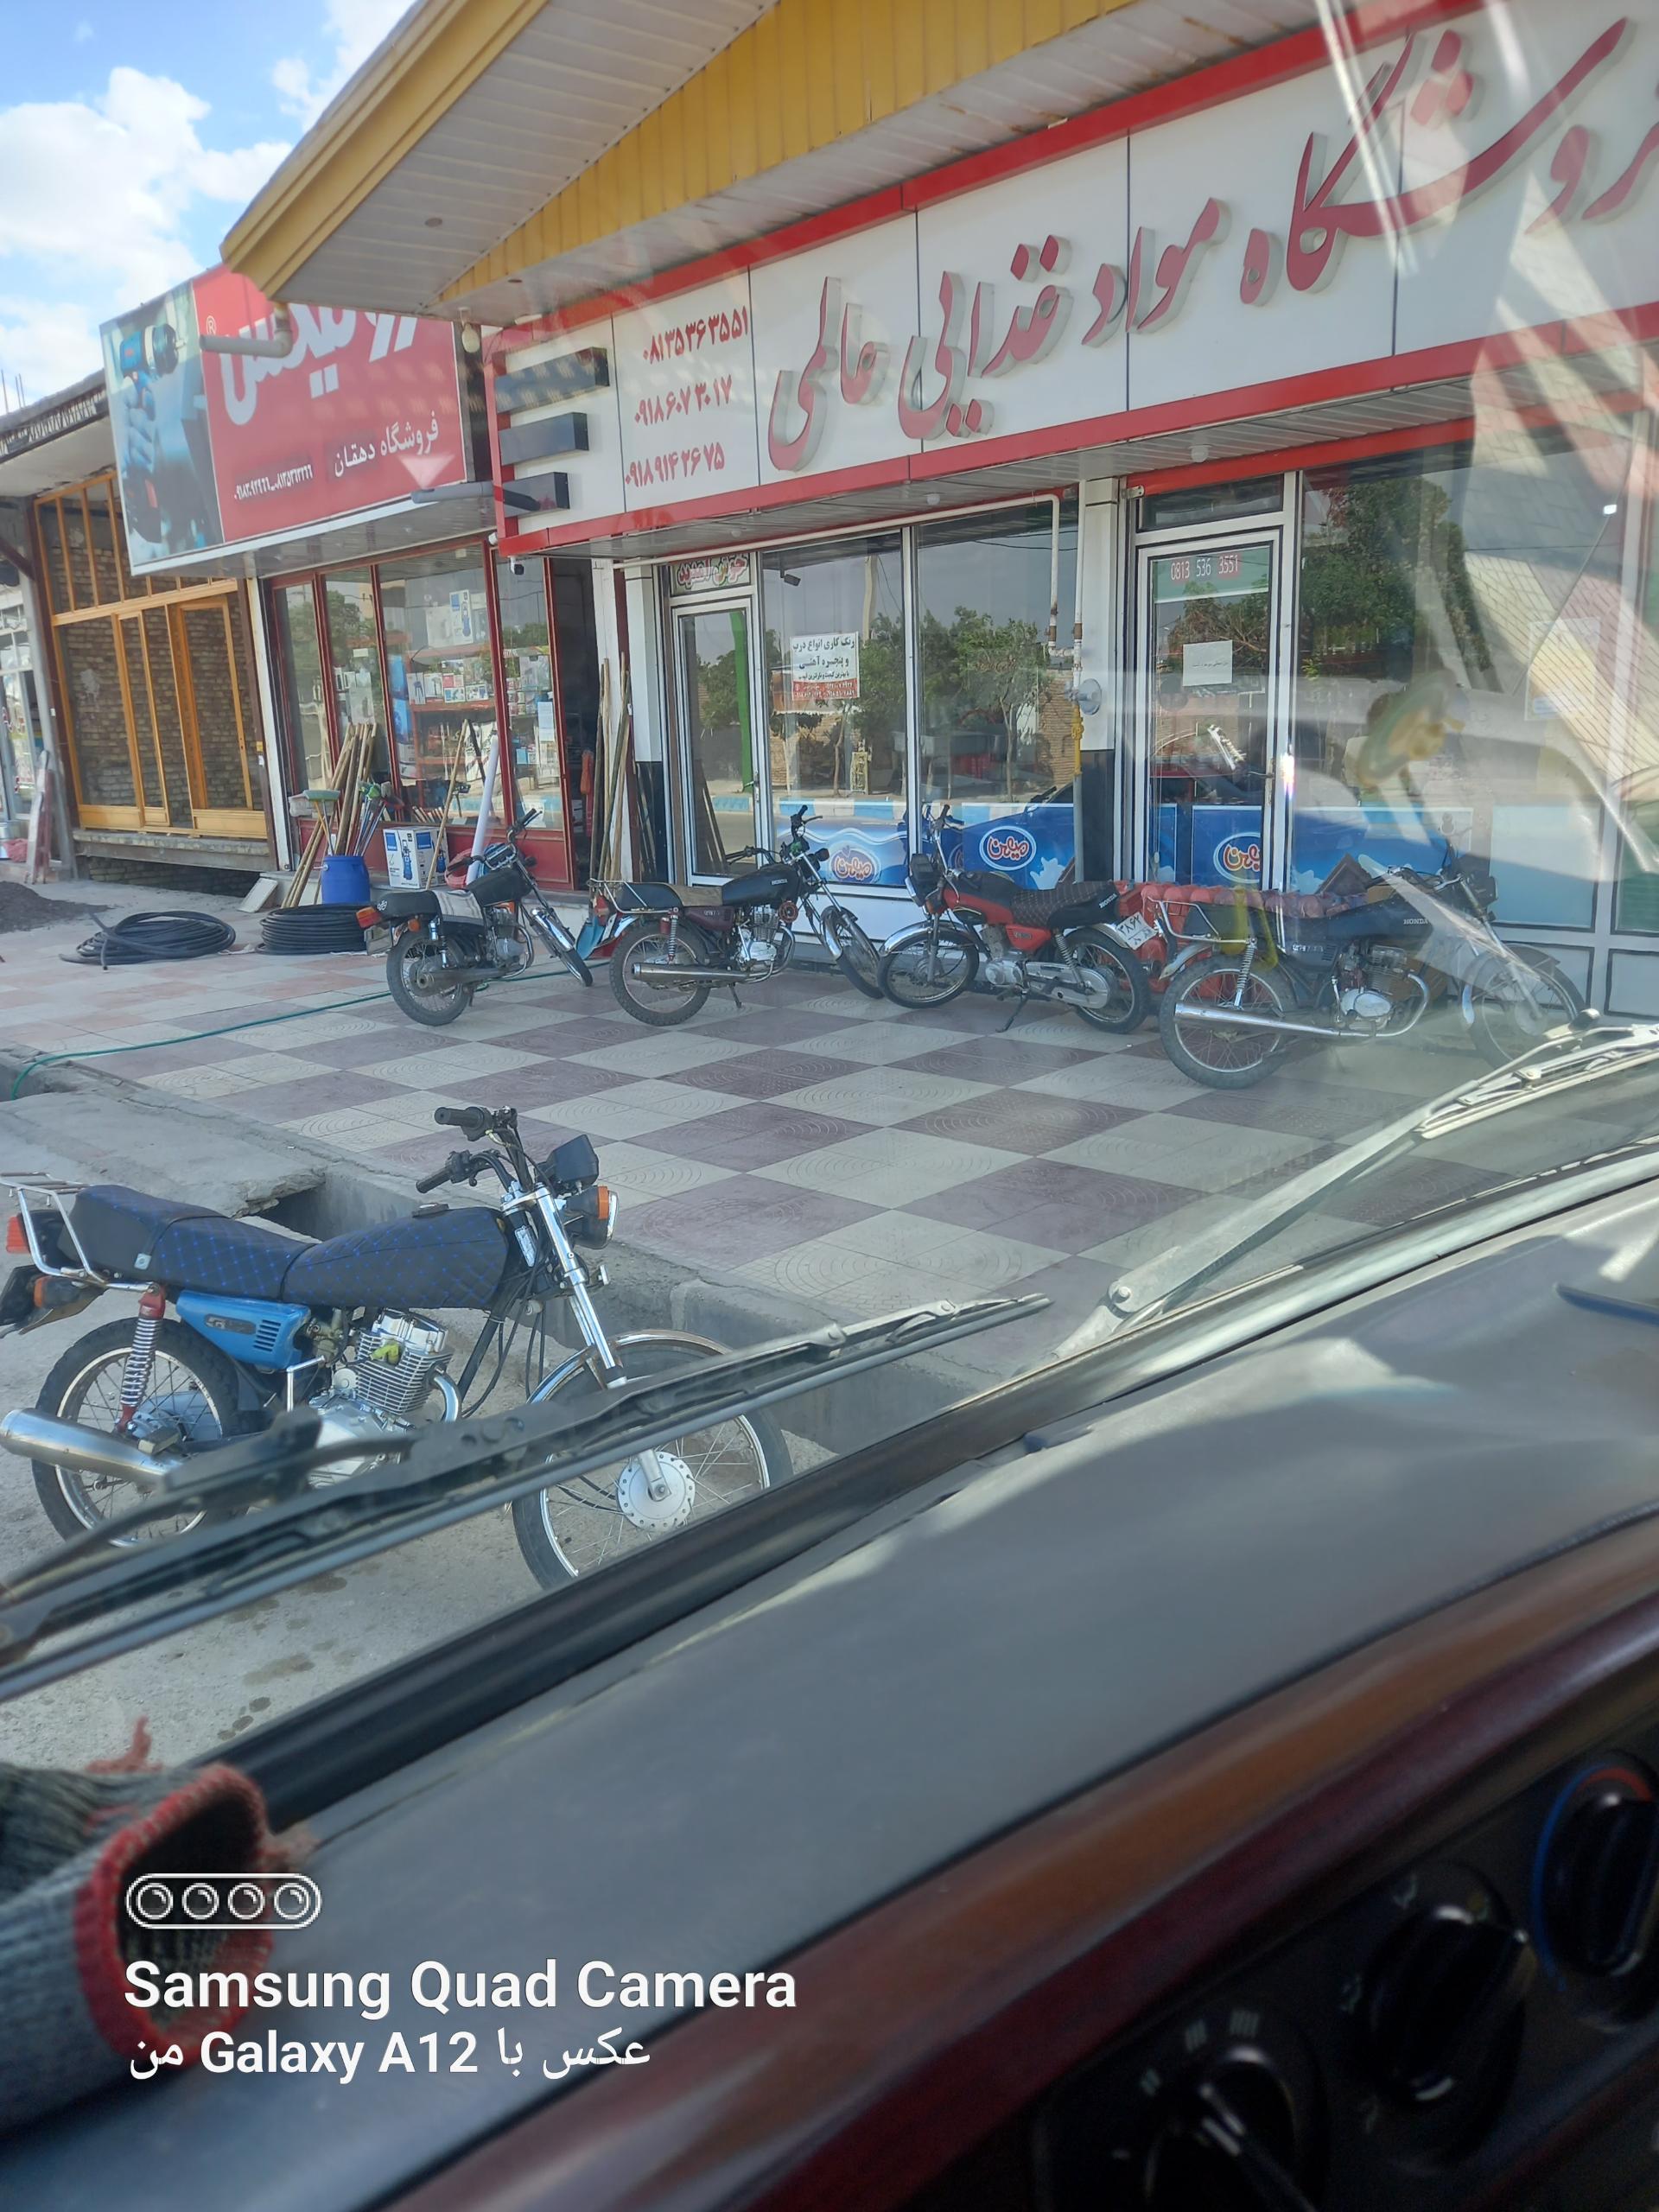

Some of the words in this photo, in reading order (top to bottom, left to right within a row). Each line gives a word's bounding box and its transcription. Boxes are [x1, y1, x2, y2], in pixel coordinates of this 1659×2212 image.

[1240, 16, 1659, 306] روشگاه
[1081, 197, 1232, 348] مواد
[898, 234, 1073, 439] غذایی
[767, 276, 890, 472] عالی
[380, 410, 439, 456] فروشگاه
[334, 442, 376, 478] دهقان
[1170, 561, 1190, 581] 0813
[1196, 558, 1211, 577] 536
[1218, 555, 1238, 575] 3551
[792, 642, 806, 652] درب
[808, 639, 823, 652] انواع
[823, 636, 840, 650] کاری
[822, 657, 843, 668] پنجره
[987, 836, 1030, 861] میهن
[833, 855, 873, 880] میهن
